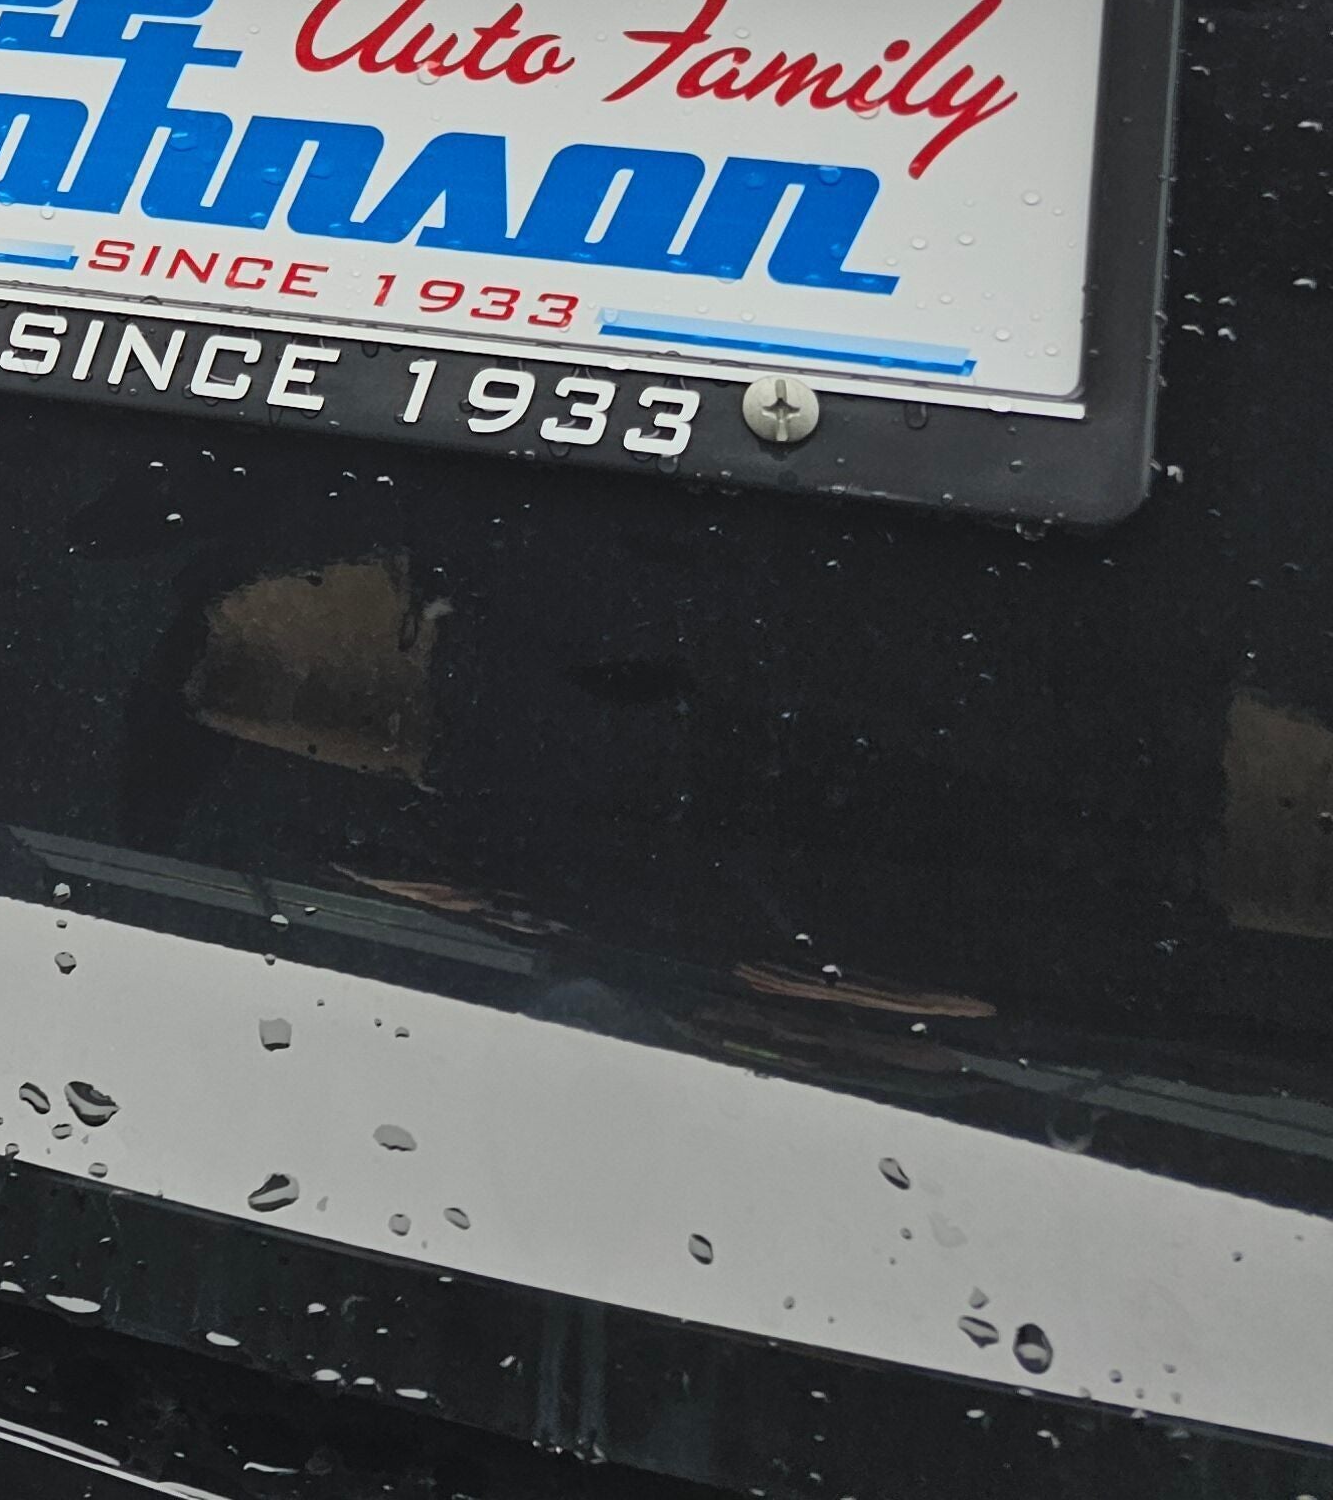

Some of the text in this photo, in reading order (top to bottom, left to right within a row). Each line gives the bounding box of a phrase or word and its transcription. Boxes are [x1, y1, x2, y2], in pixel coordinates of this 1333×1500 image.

[85, 238, 579, 332] SINCE 1933
[401, 357, 703, 460] 1933
